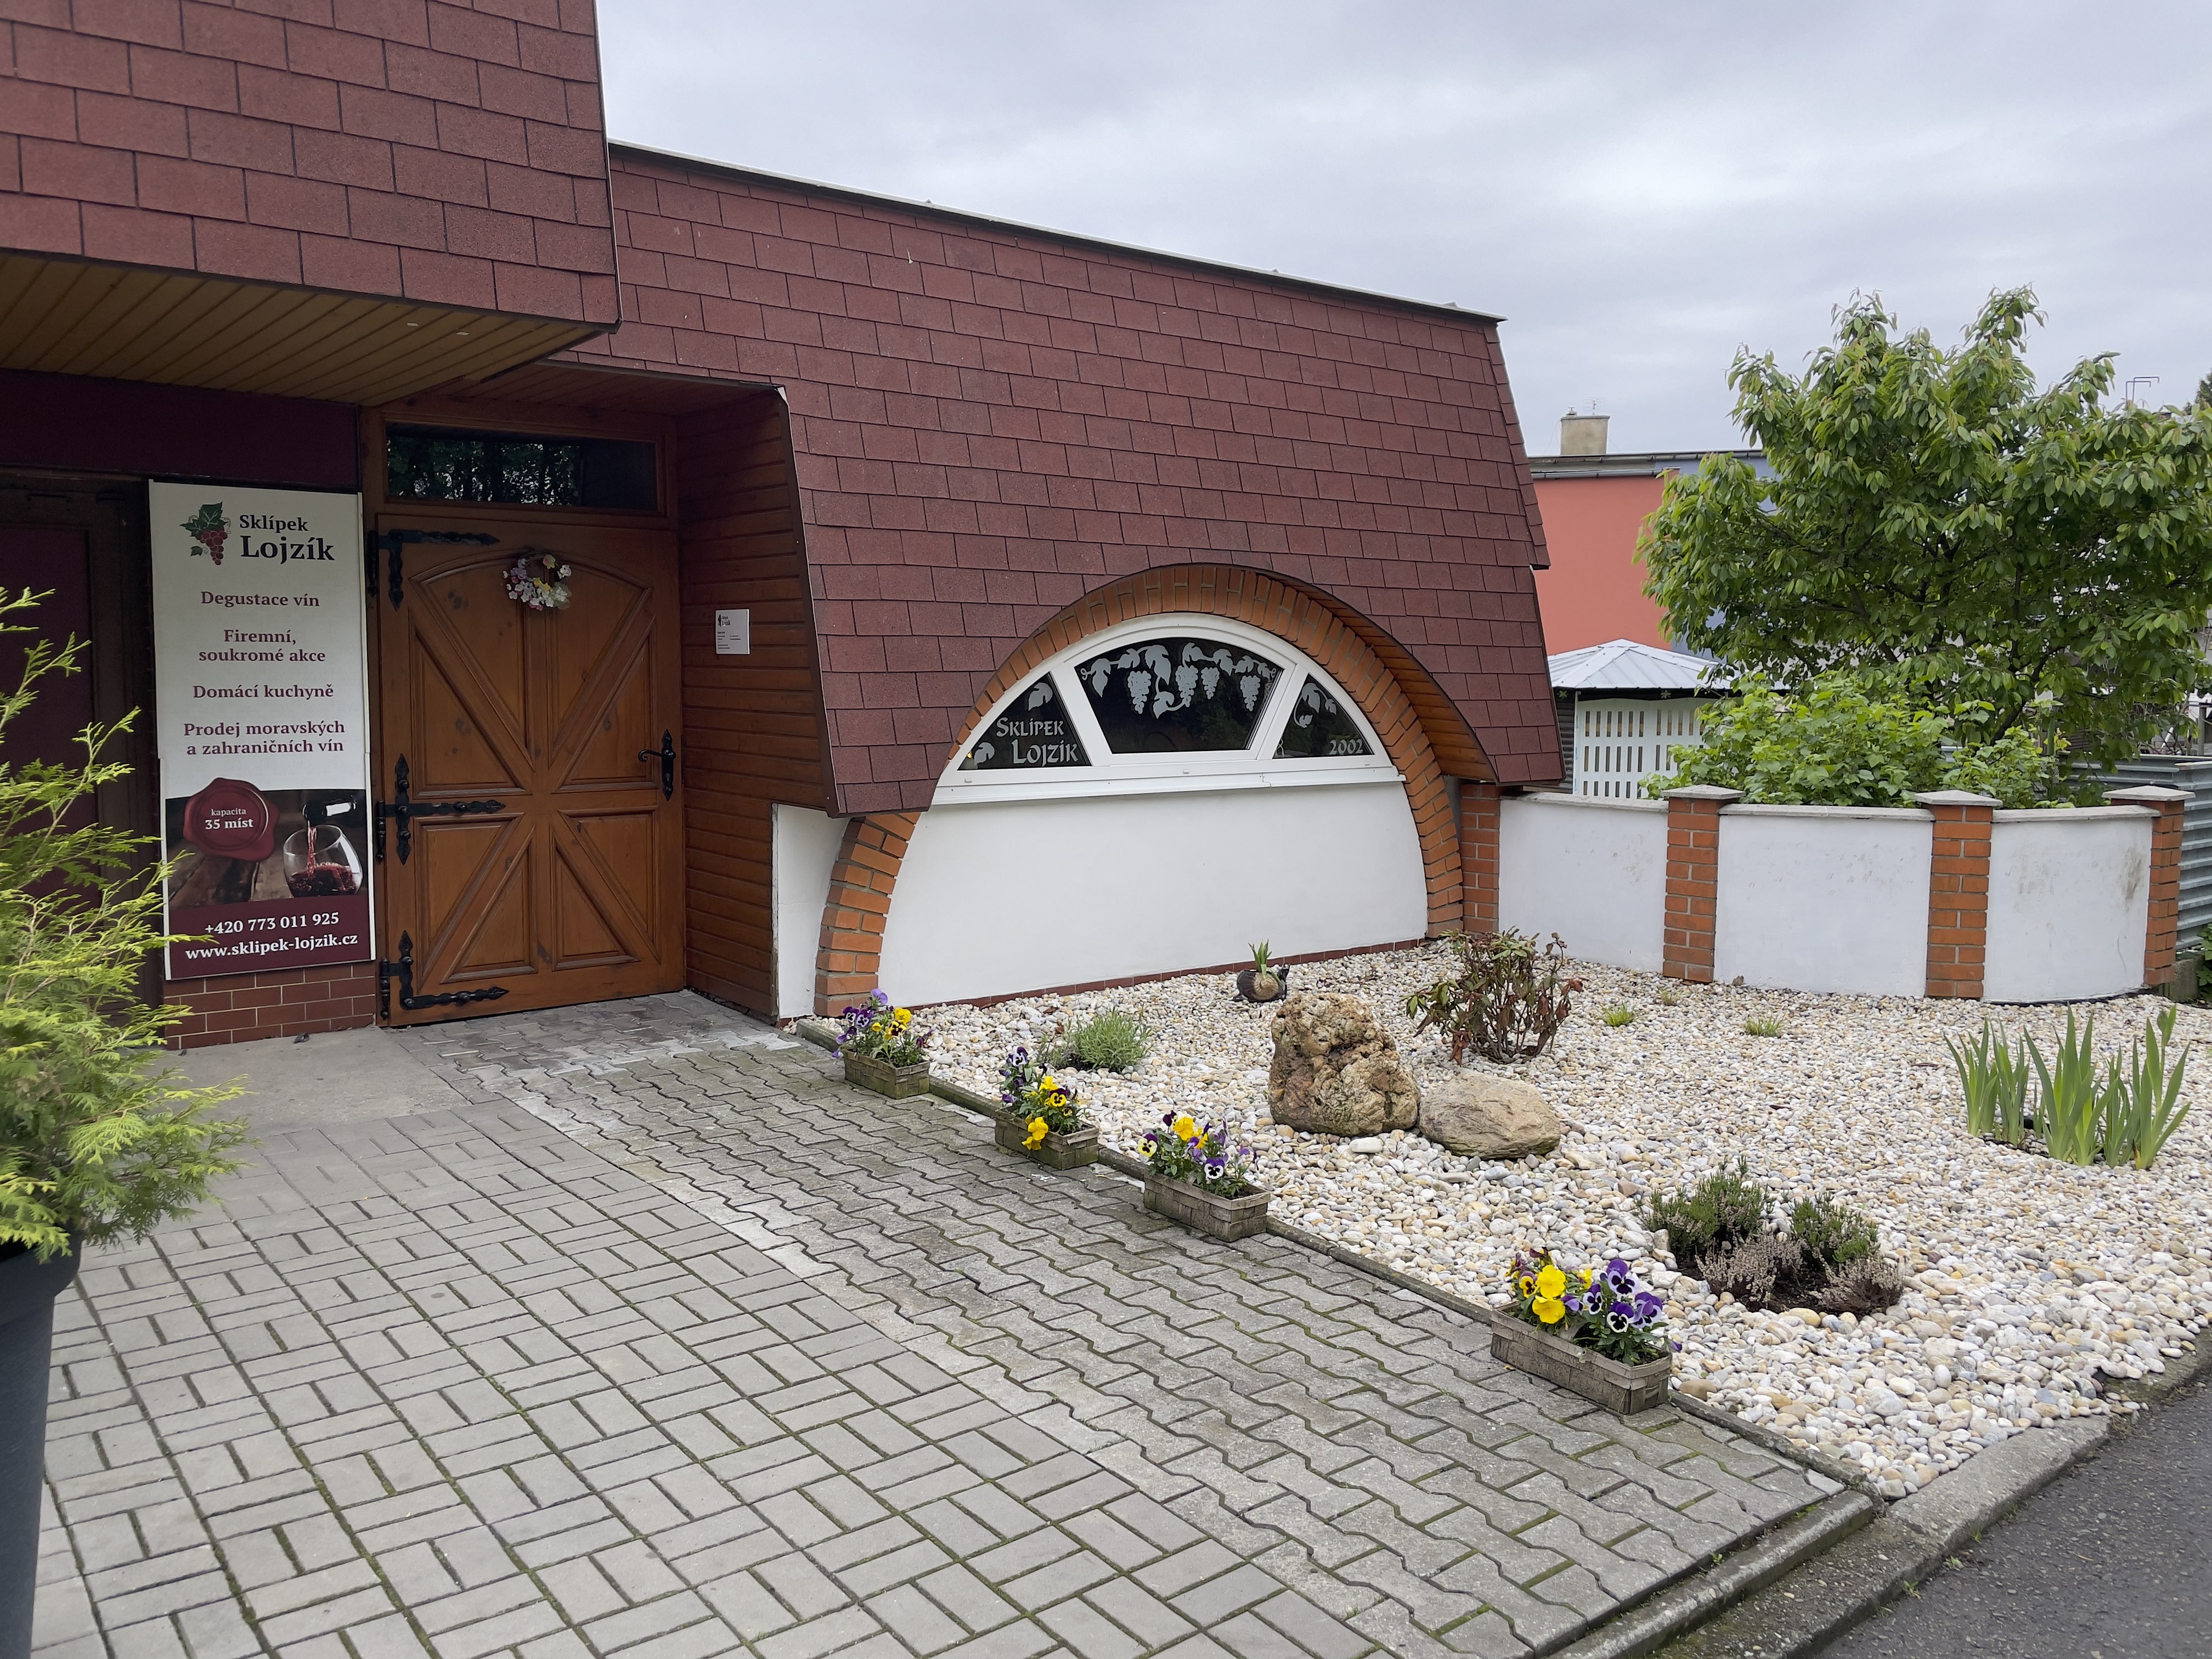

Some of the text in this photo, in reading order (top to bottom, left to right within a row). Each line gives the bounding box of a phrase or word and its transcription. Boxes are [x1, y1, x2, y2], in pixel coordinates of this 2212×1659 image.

[239, 515, 308, 533] Sklípek
[240, 535, 335, 564] Lojzík
[201, 591, 320, 607] Degustace vín
[223, 630, 297, 645] Firemní,
[199, 648, 326, 662] soukromé akce
[193, 684, 334, 700] Domácí kuchyně
[184, 721, 345, 737] Prodej moravských
[187, 740, 343, 755] a zahraničních vín
[1329, 739, 1364, 755] 2002
[211, 808, 246, 817] kapacita
[205, 818, 253, 830] 35 míst
[205, 912, 340, 934] +420 773 011 925
[185, 933, 358, 959] www.sklipek-lojzik.cz
